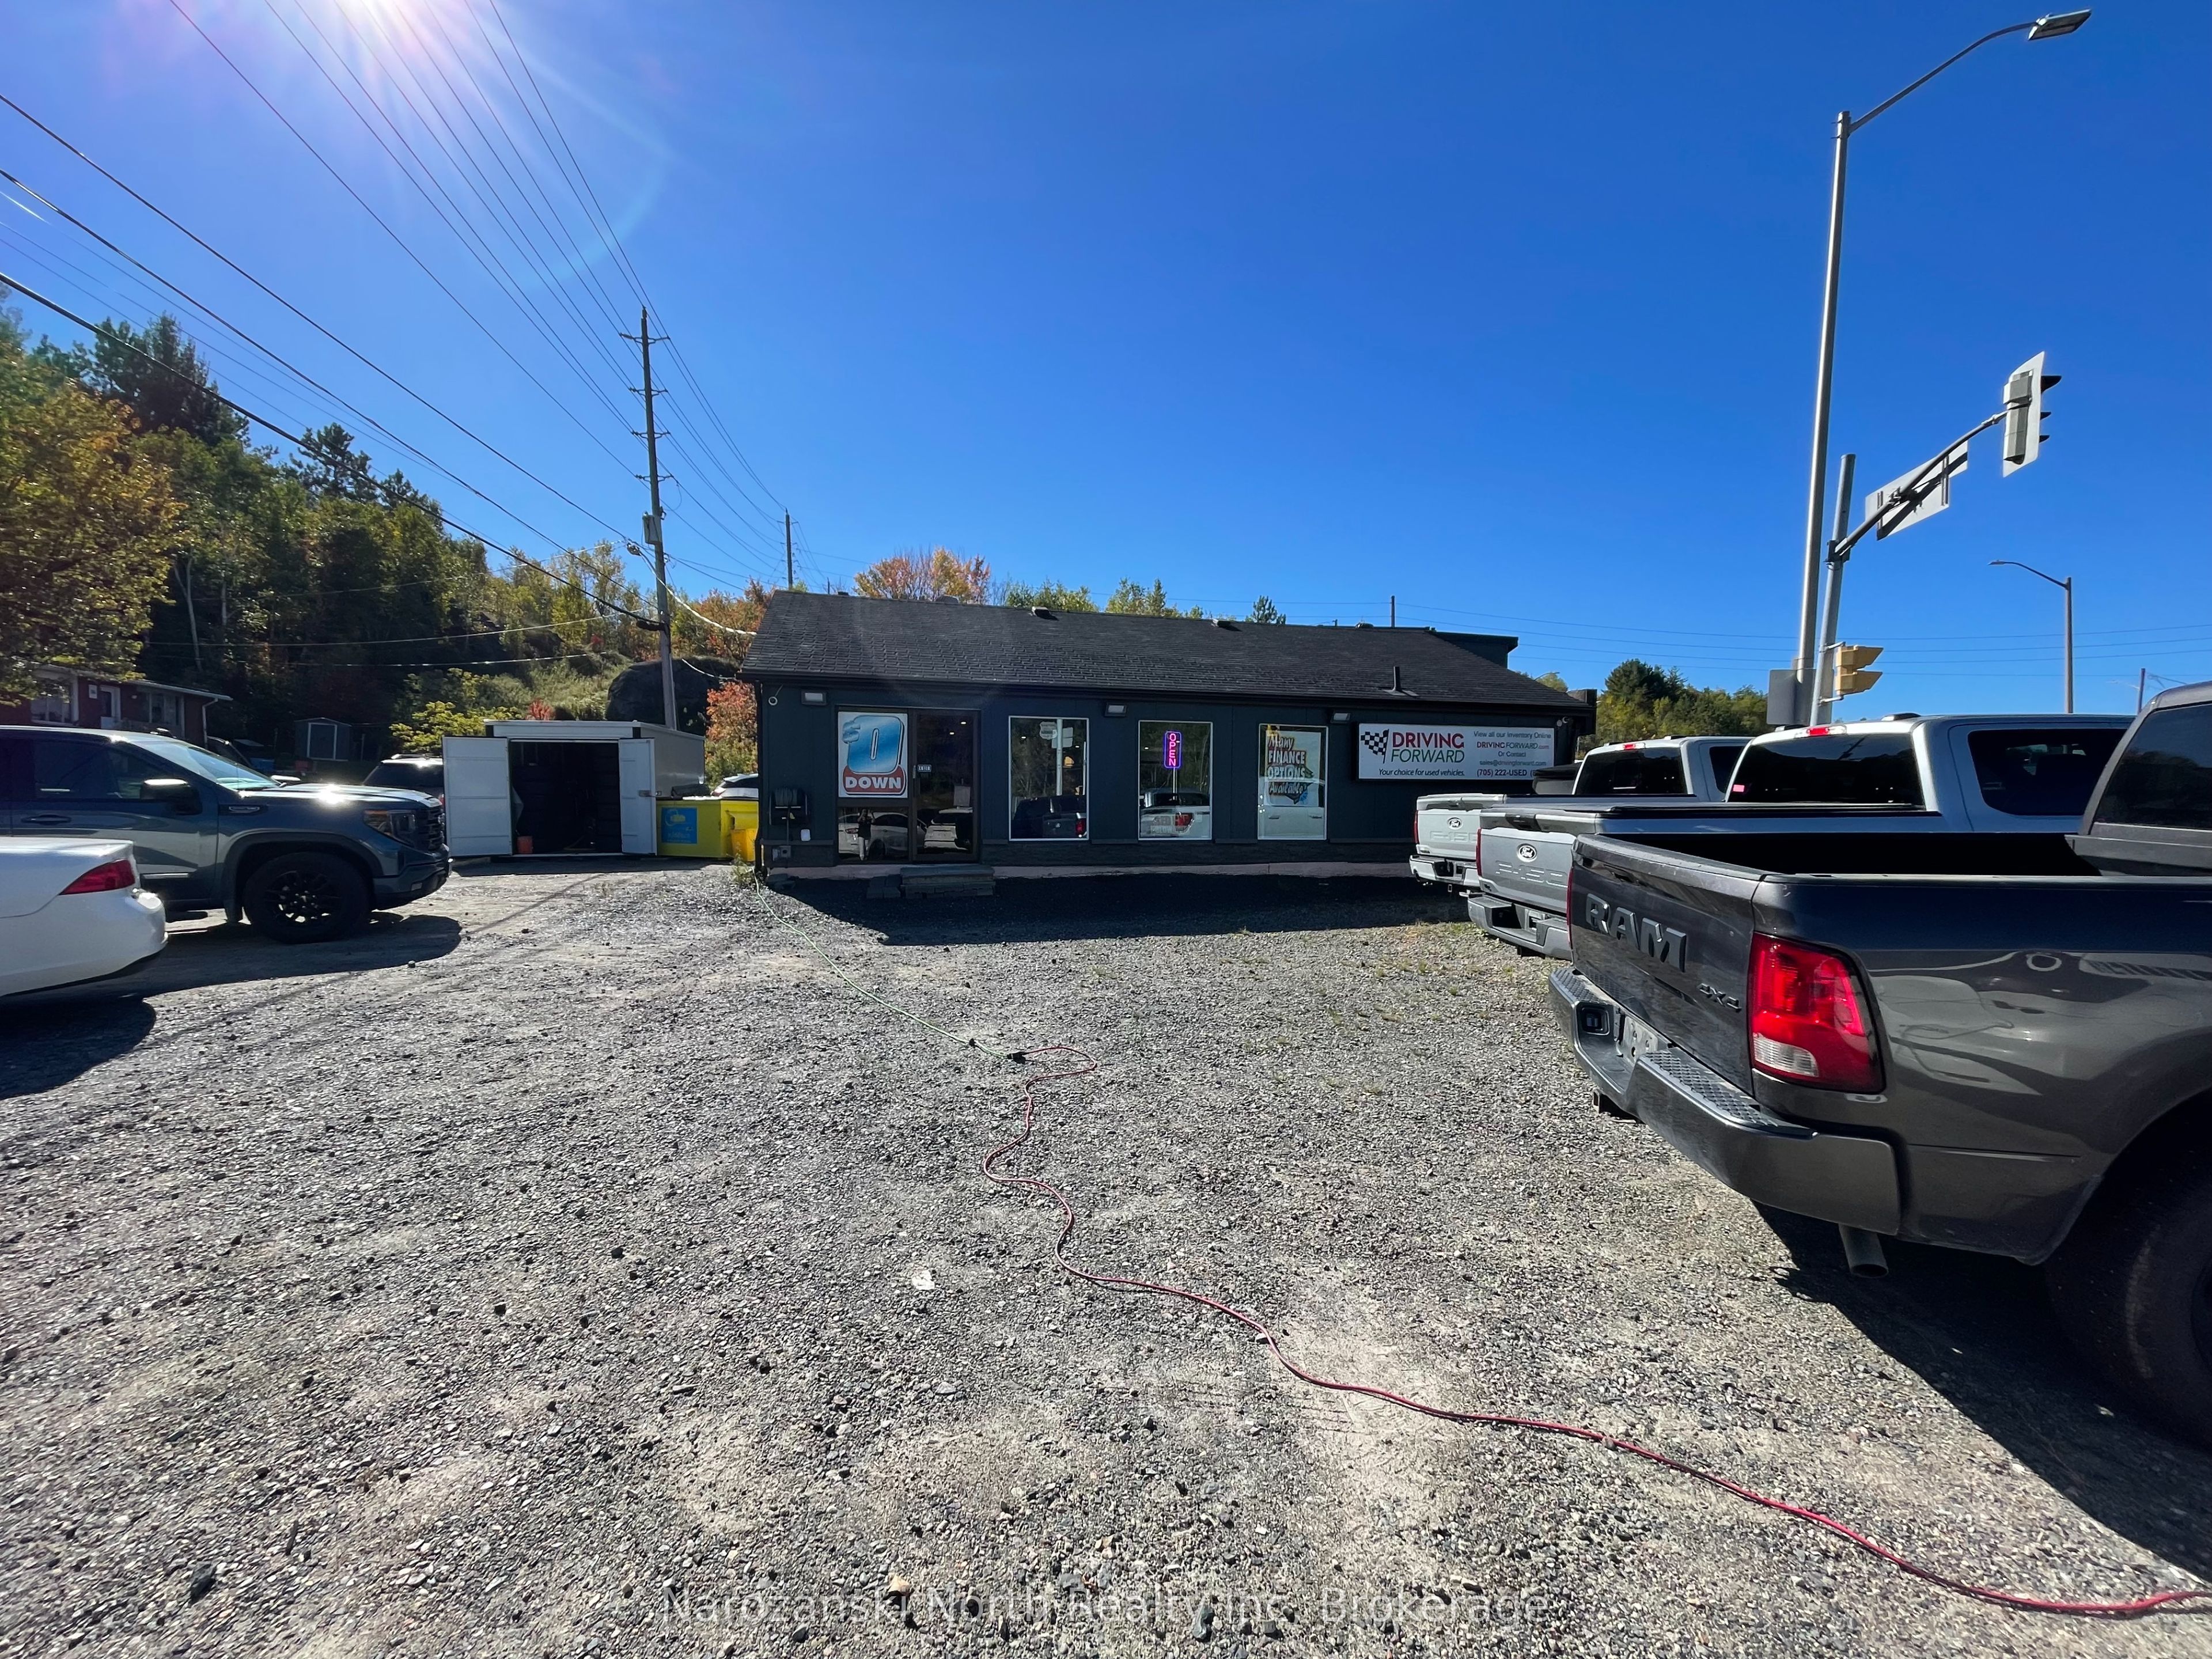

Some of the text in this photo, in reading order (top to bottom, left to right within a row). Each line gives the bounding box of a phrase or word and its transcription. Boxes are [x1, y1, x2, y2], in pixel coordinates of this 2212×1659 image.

[1268, 733, 1294, 751] Many
[1392, 732, 1464, 749] DRIVING
[1268, 750, 1305, 764] FINANCE
[1391, 749, 1465, 763] FORWARD
[1267, 766, 1305, 780] OPTIONS
[1476, 769, 1493, 777] (705)
[845, 777, 902, 789] DOWN
[1585, 893, 1687, 974] RAM
